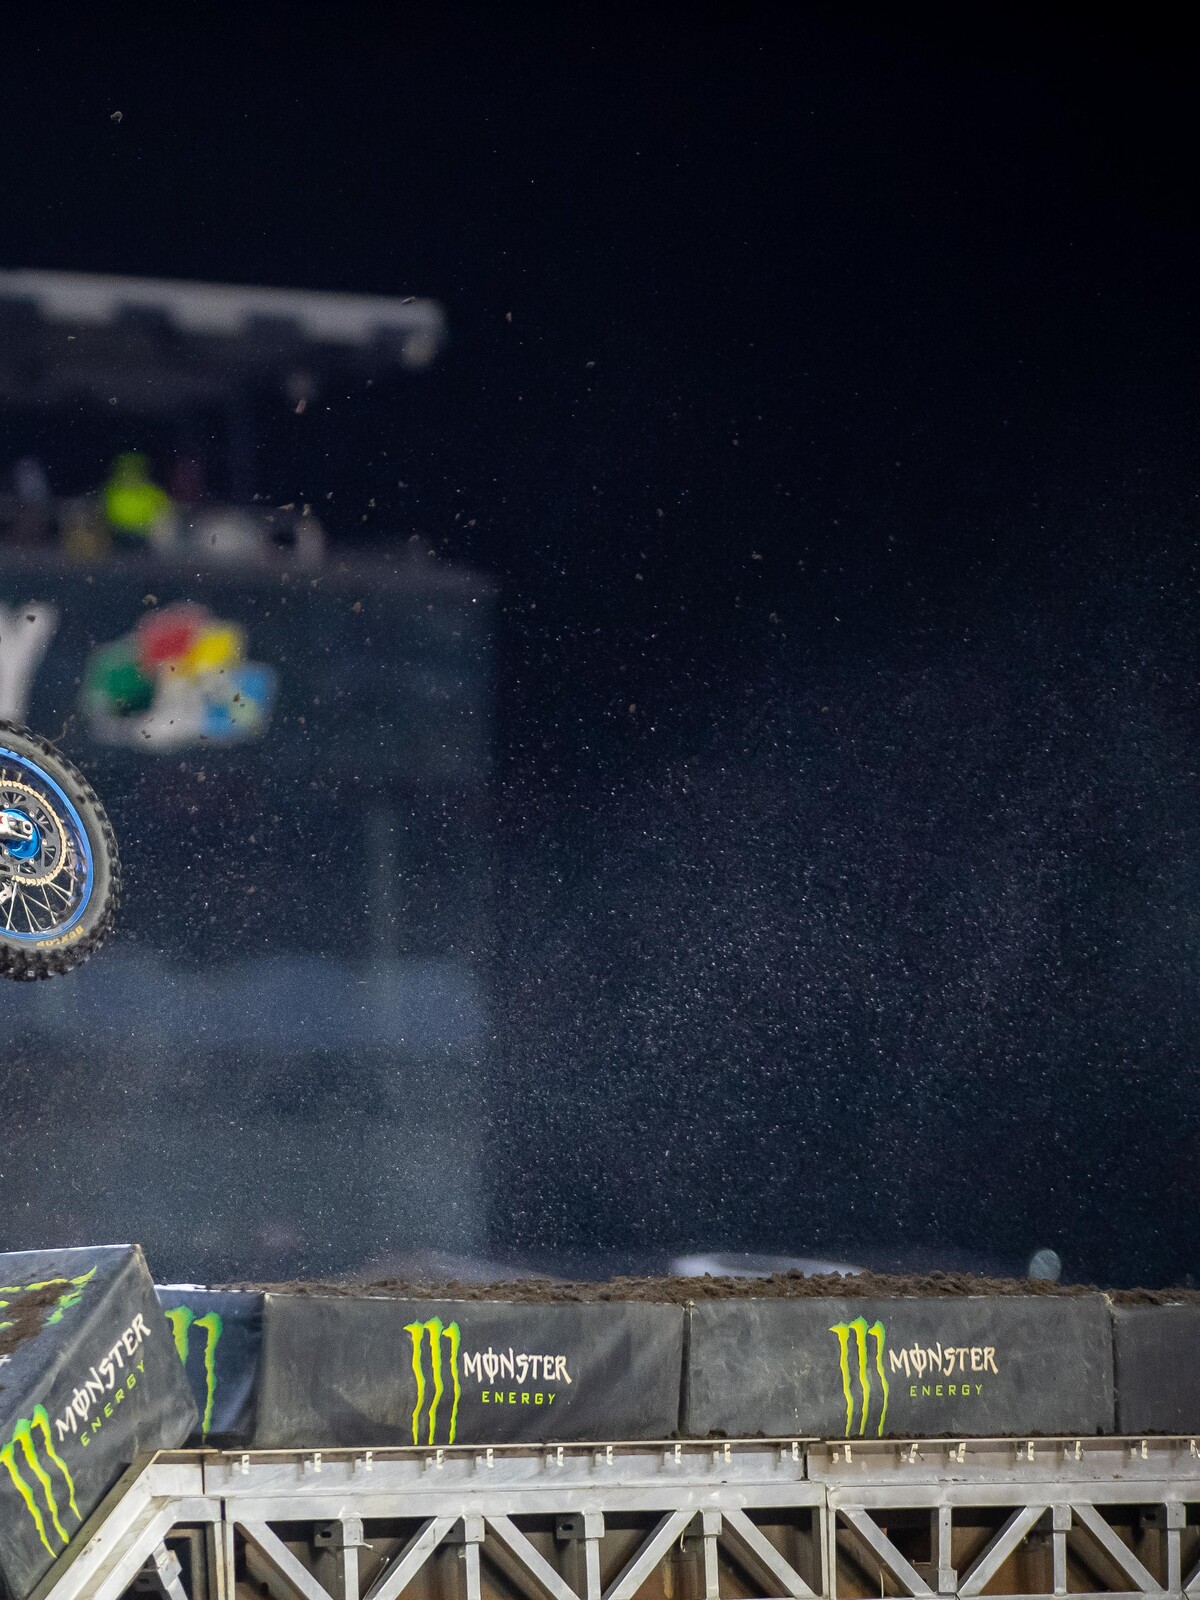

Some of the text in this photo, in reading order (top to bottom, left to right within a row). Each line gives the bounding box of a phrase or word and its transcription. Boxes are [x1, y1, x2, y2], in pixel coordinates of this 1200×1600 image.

[55, 1312, 152, 1441] MONSTER
[463, 1346, 572, 1385] MONSTER
[888, 1341, 999, 1378] MONSTER
[80, 1360, 146, 1447] ENERGY
[481, 1390, 557, 1406] ENERGY
[909, 1384, 984, 1398] ENERGY
